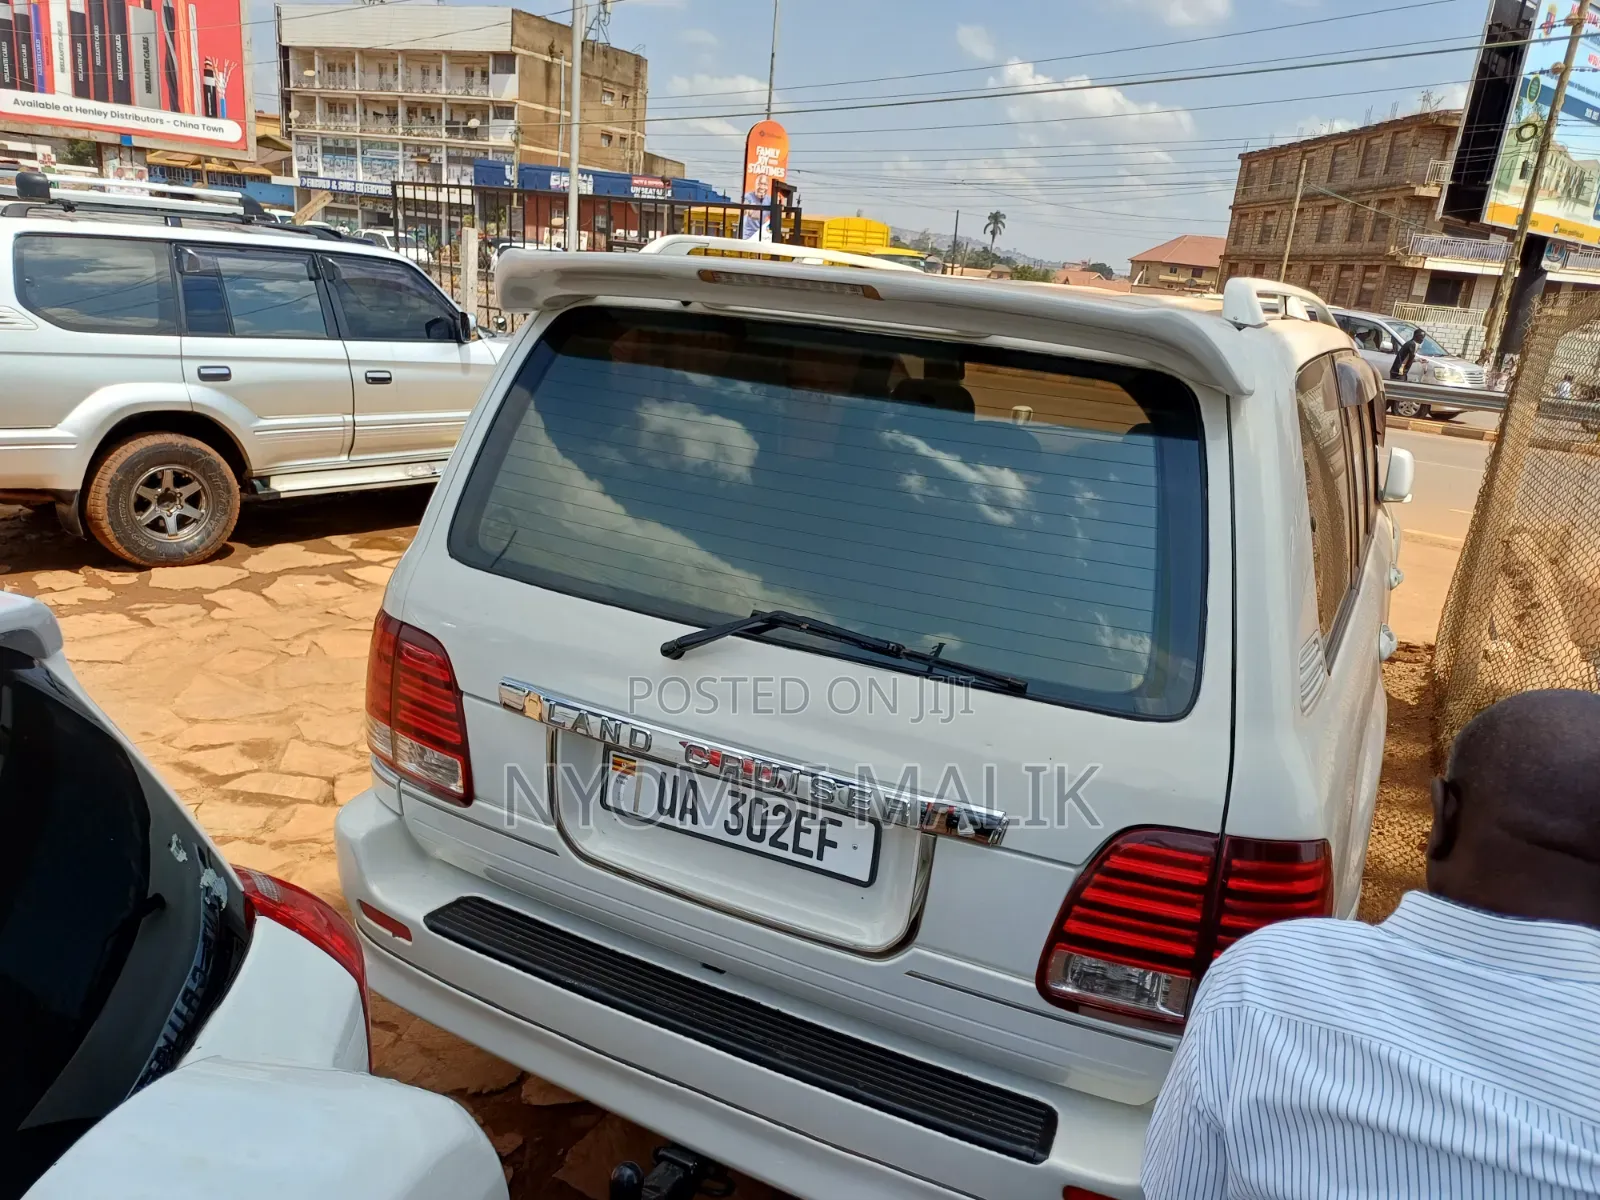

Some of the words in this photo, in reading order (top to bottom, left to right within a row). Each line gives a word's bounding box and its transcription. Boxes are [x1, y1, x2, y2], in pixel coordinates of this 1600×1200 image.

[142, 36, 150, 59] CABLES
[13, 97, 60, 111] Available
[62, 103, 73, 113] at
[75, 105, 108, 119] Henley
[110, 110, 164, 126] Distributors
[173, 119, 199, 131] China
[201, 123, 225, 134] Town
[756, 145, 780, 158] FAMILY
[748, 163, 785, 177] STARTIMES
[630, 186, 672, 197] UNBEATALE
[547, 700, 653, 753] LAND
[684, 741, 911, 822] CRUISER
[656, 770, 699, 826] UA
[723, 789, 843, 862] 302EF
